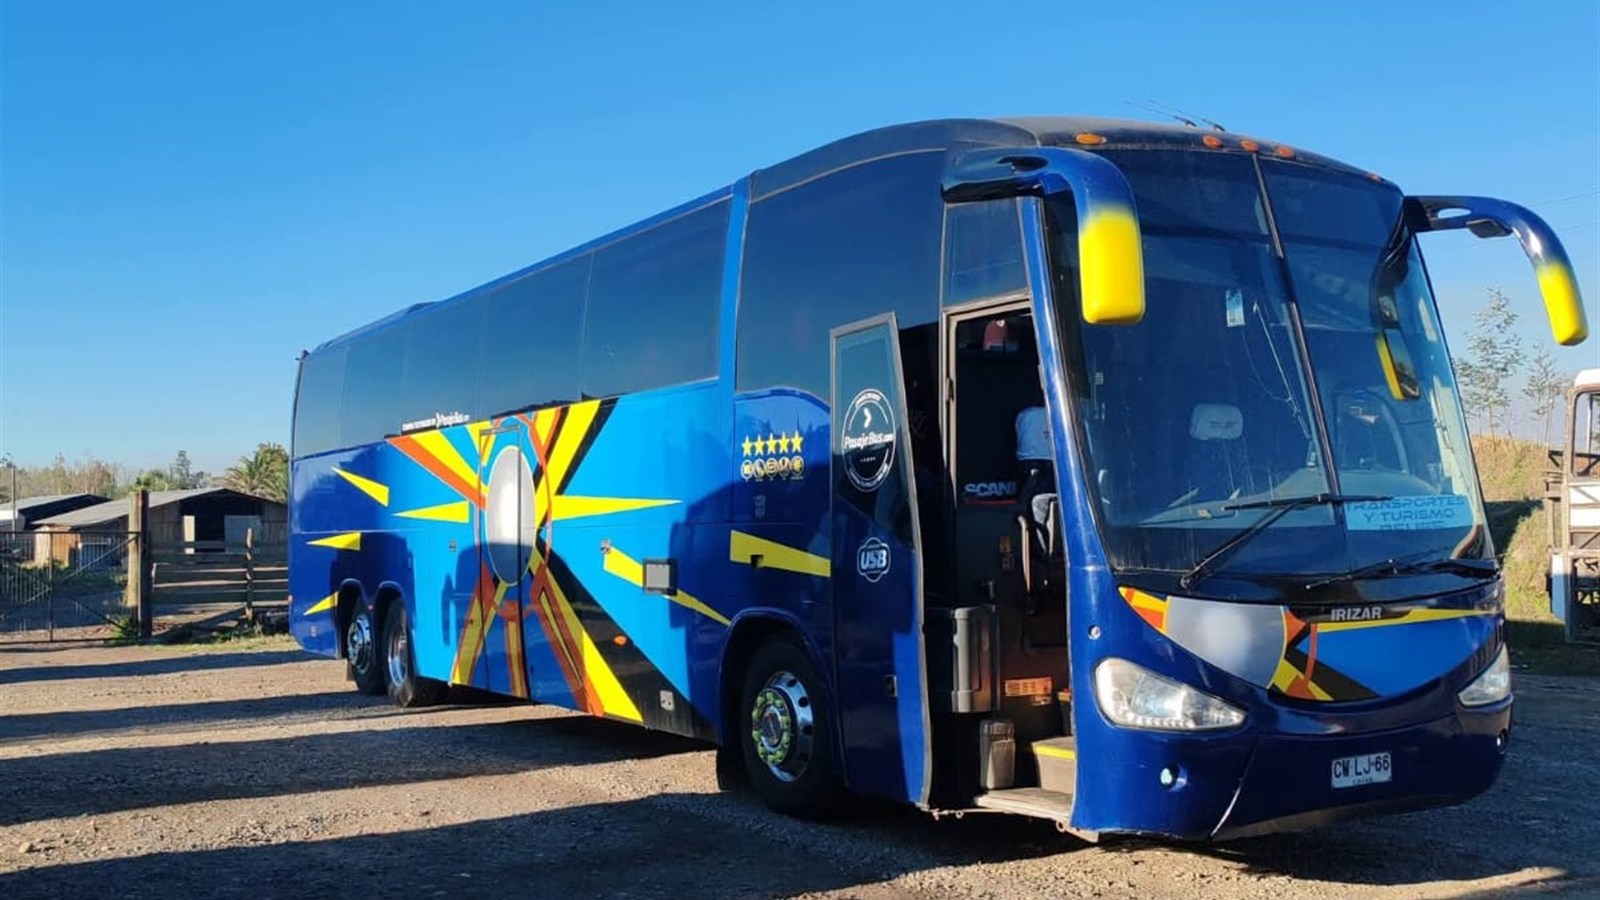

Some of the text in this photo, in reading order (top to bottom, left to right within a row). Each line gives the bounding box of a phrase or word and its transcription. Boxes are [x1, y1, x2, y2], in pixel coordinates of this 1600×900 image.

[1363, 508, 1455, 523] Y TURISMO
[861, 549, 887, 570] USB
[1331, 606, 1382, 621] IRIZAR
